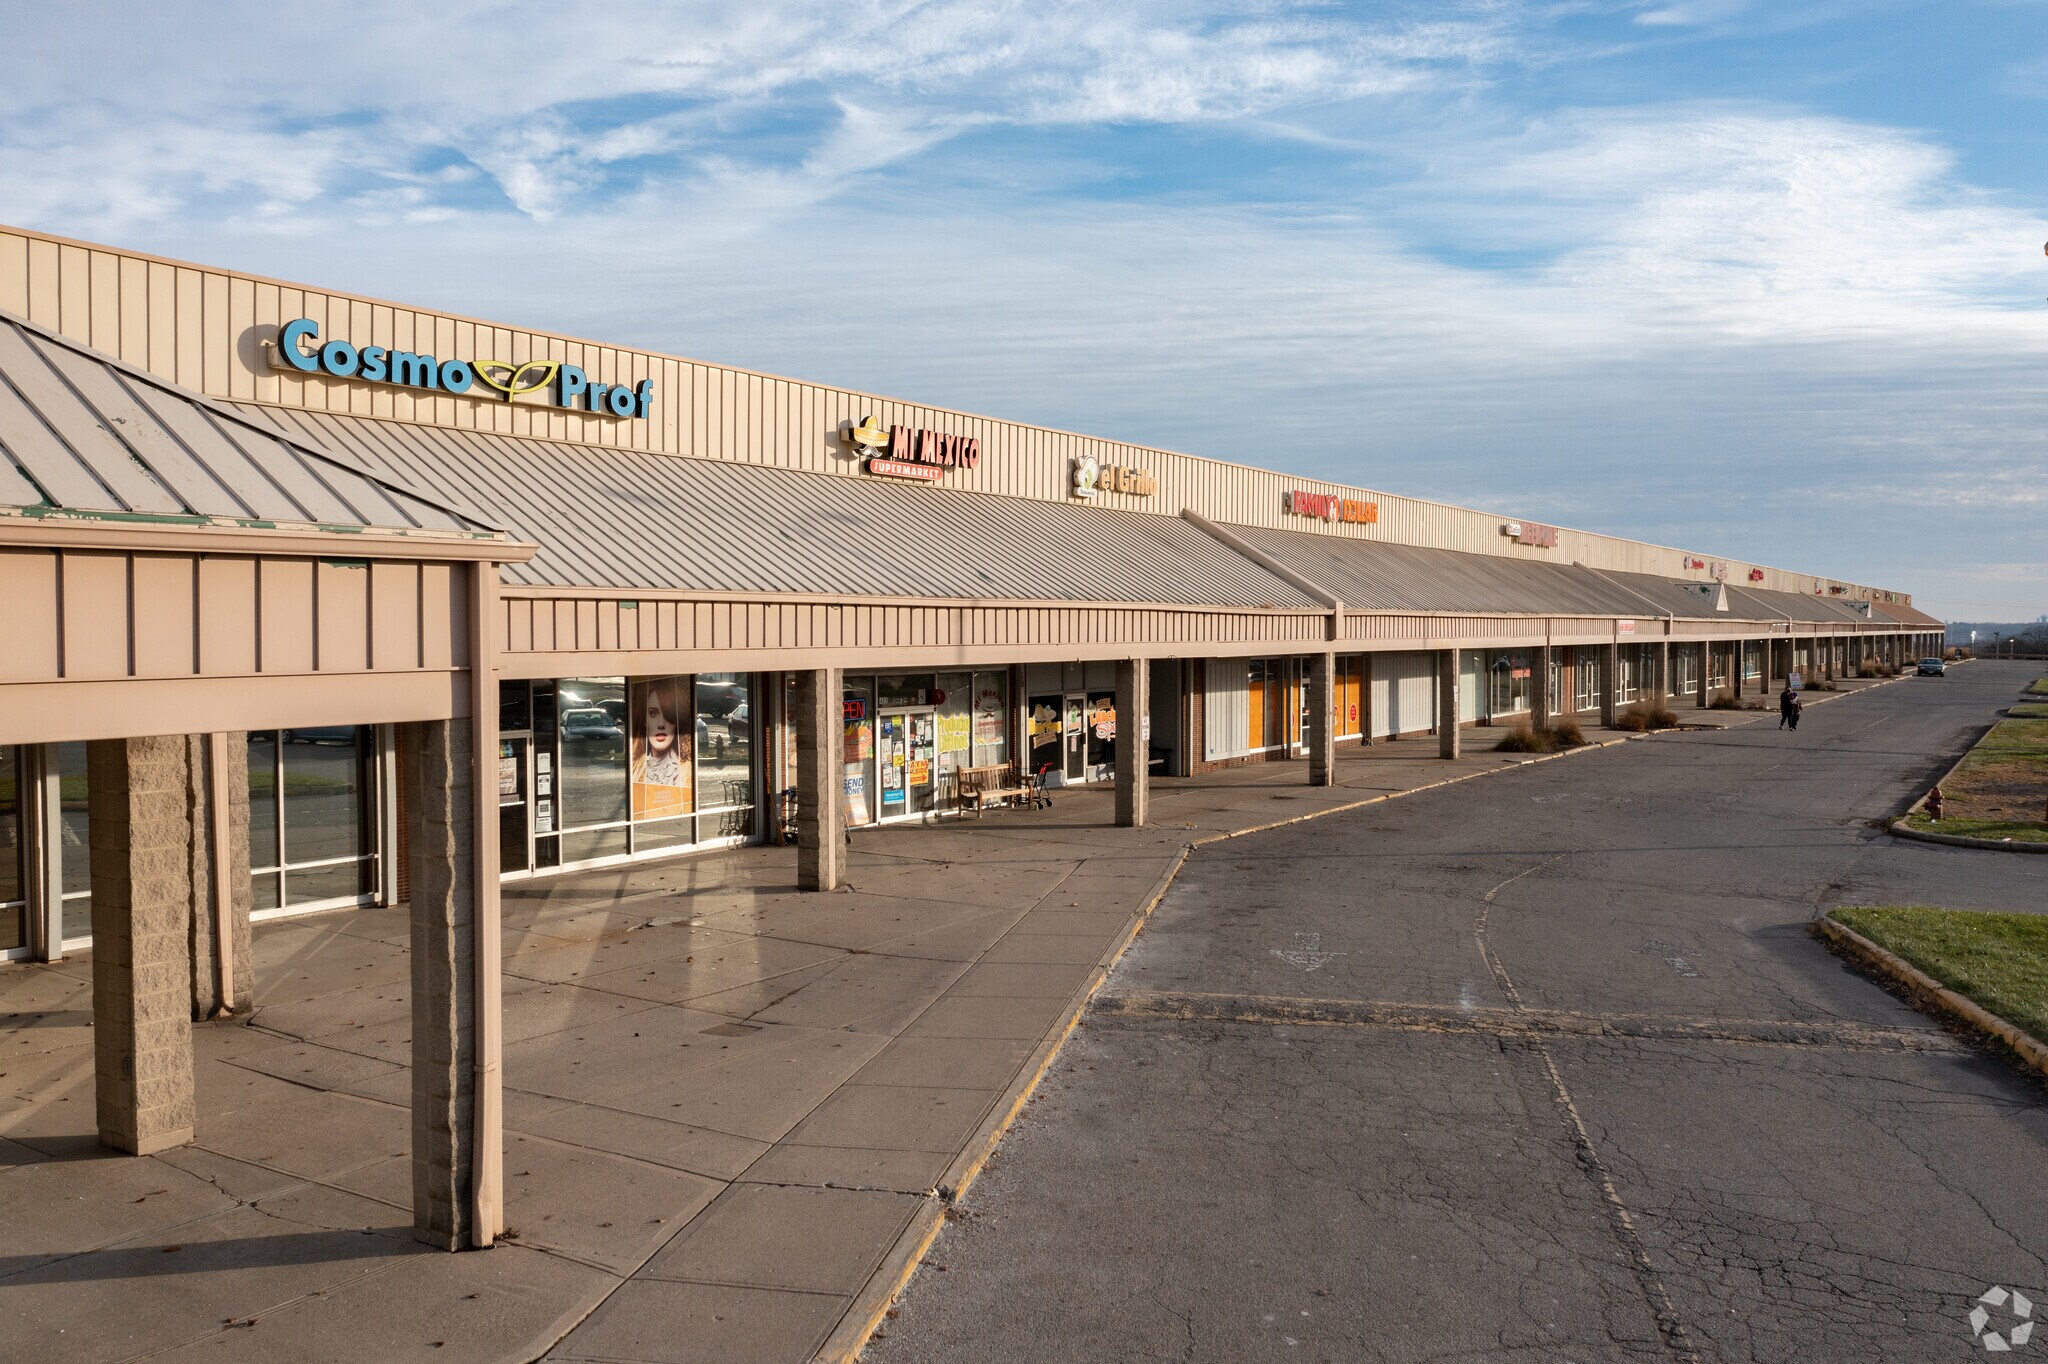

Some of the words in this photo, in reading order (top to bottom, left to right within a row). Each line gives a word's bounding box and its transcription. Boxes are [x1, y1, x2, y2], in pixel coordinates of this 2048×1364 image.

[278, 318, 473, 394] Cosmo
[557, 364, 653, 418] Prof
[889, 425, 914, 460] MI
[918, 428, 980, 470] MEXICO
[873, 461, 939, 479] SUPERMARKET
[1100, 463, 1115, 490] el
[1118, 464, 1158, 496] Grillo
[1292, 490, 1330, 516] FAMILY
[1342, 498, 1378, 523] DOLLAR
[842, 701, 865, 720] PEN
[843, 778, 865, 788] SEND
